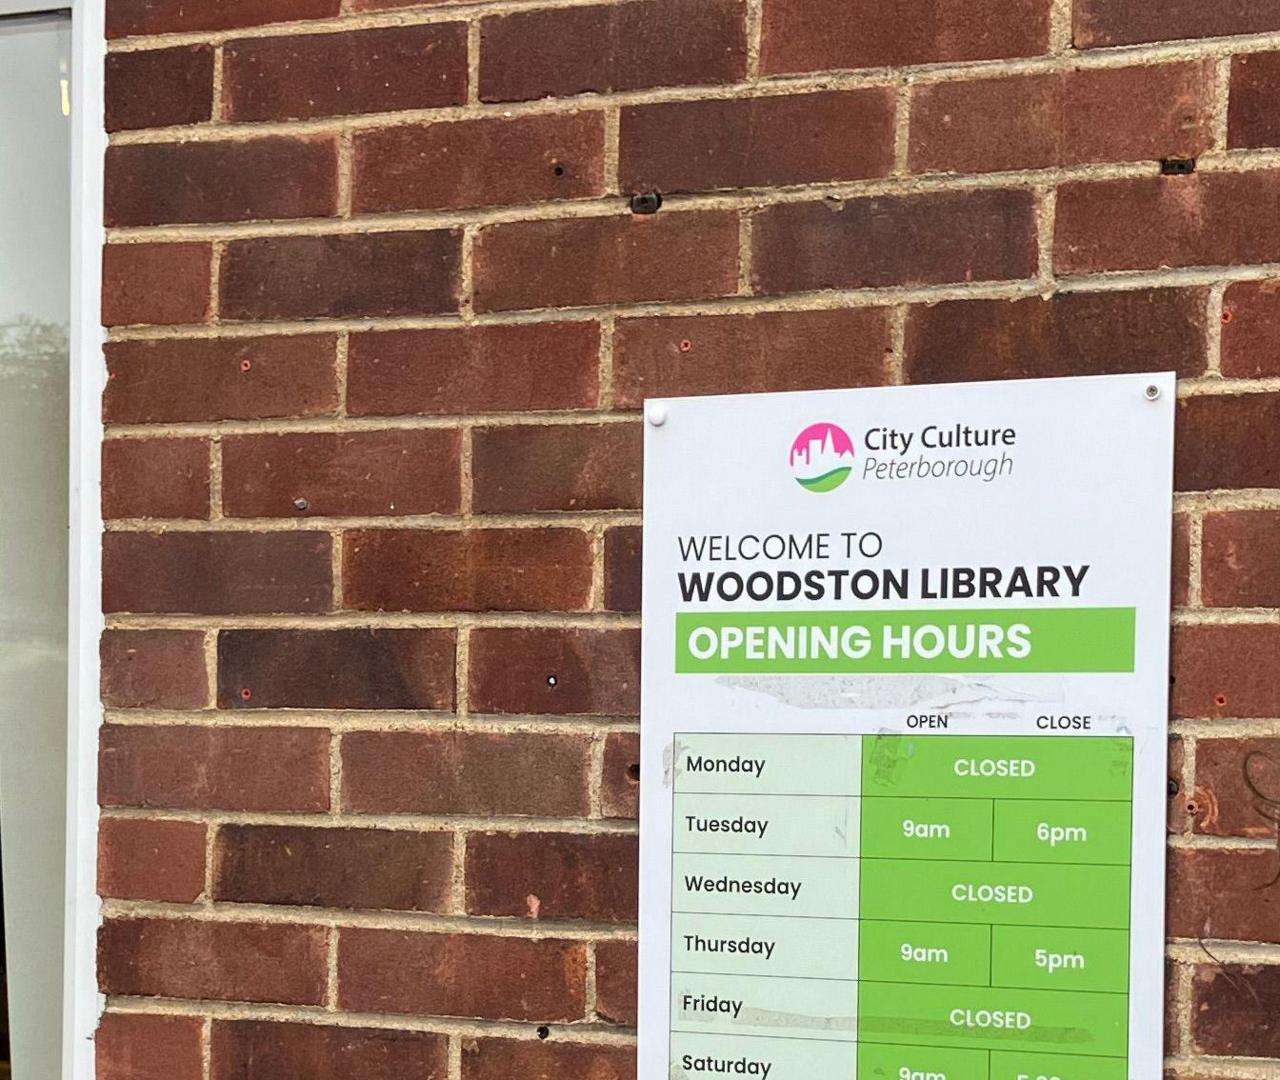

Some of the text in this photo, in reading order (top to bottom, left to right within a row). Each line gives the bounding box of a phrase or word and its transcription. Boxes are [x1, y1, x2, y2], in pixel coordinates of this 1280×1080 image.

[865, 424, 1015, 456] City Culture
[863, 453, 1013, 482] Peterborough
[678, 532, 882, 561] WELCOME TO
[678, 565, 1089, 602] WOODSTON LIBRARY
[689, 624, 1031, 659] OPENING HOURS
[907, 715, 1091, 729] OPEN CLOSE
[687, 756, 1035, 778] Monday CLOSED
[686, 816, 1086, 846] Tuesday 9am 6pm
[685, 876, 1032, 902] Wednesday CLOSED
[684, 935, 1084, 972] Thursday 9am 5pm
[684, 995, 1030, 1029] Friday CLOSED
[683, 1055, 771, 1080] Saturday
